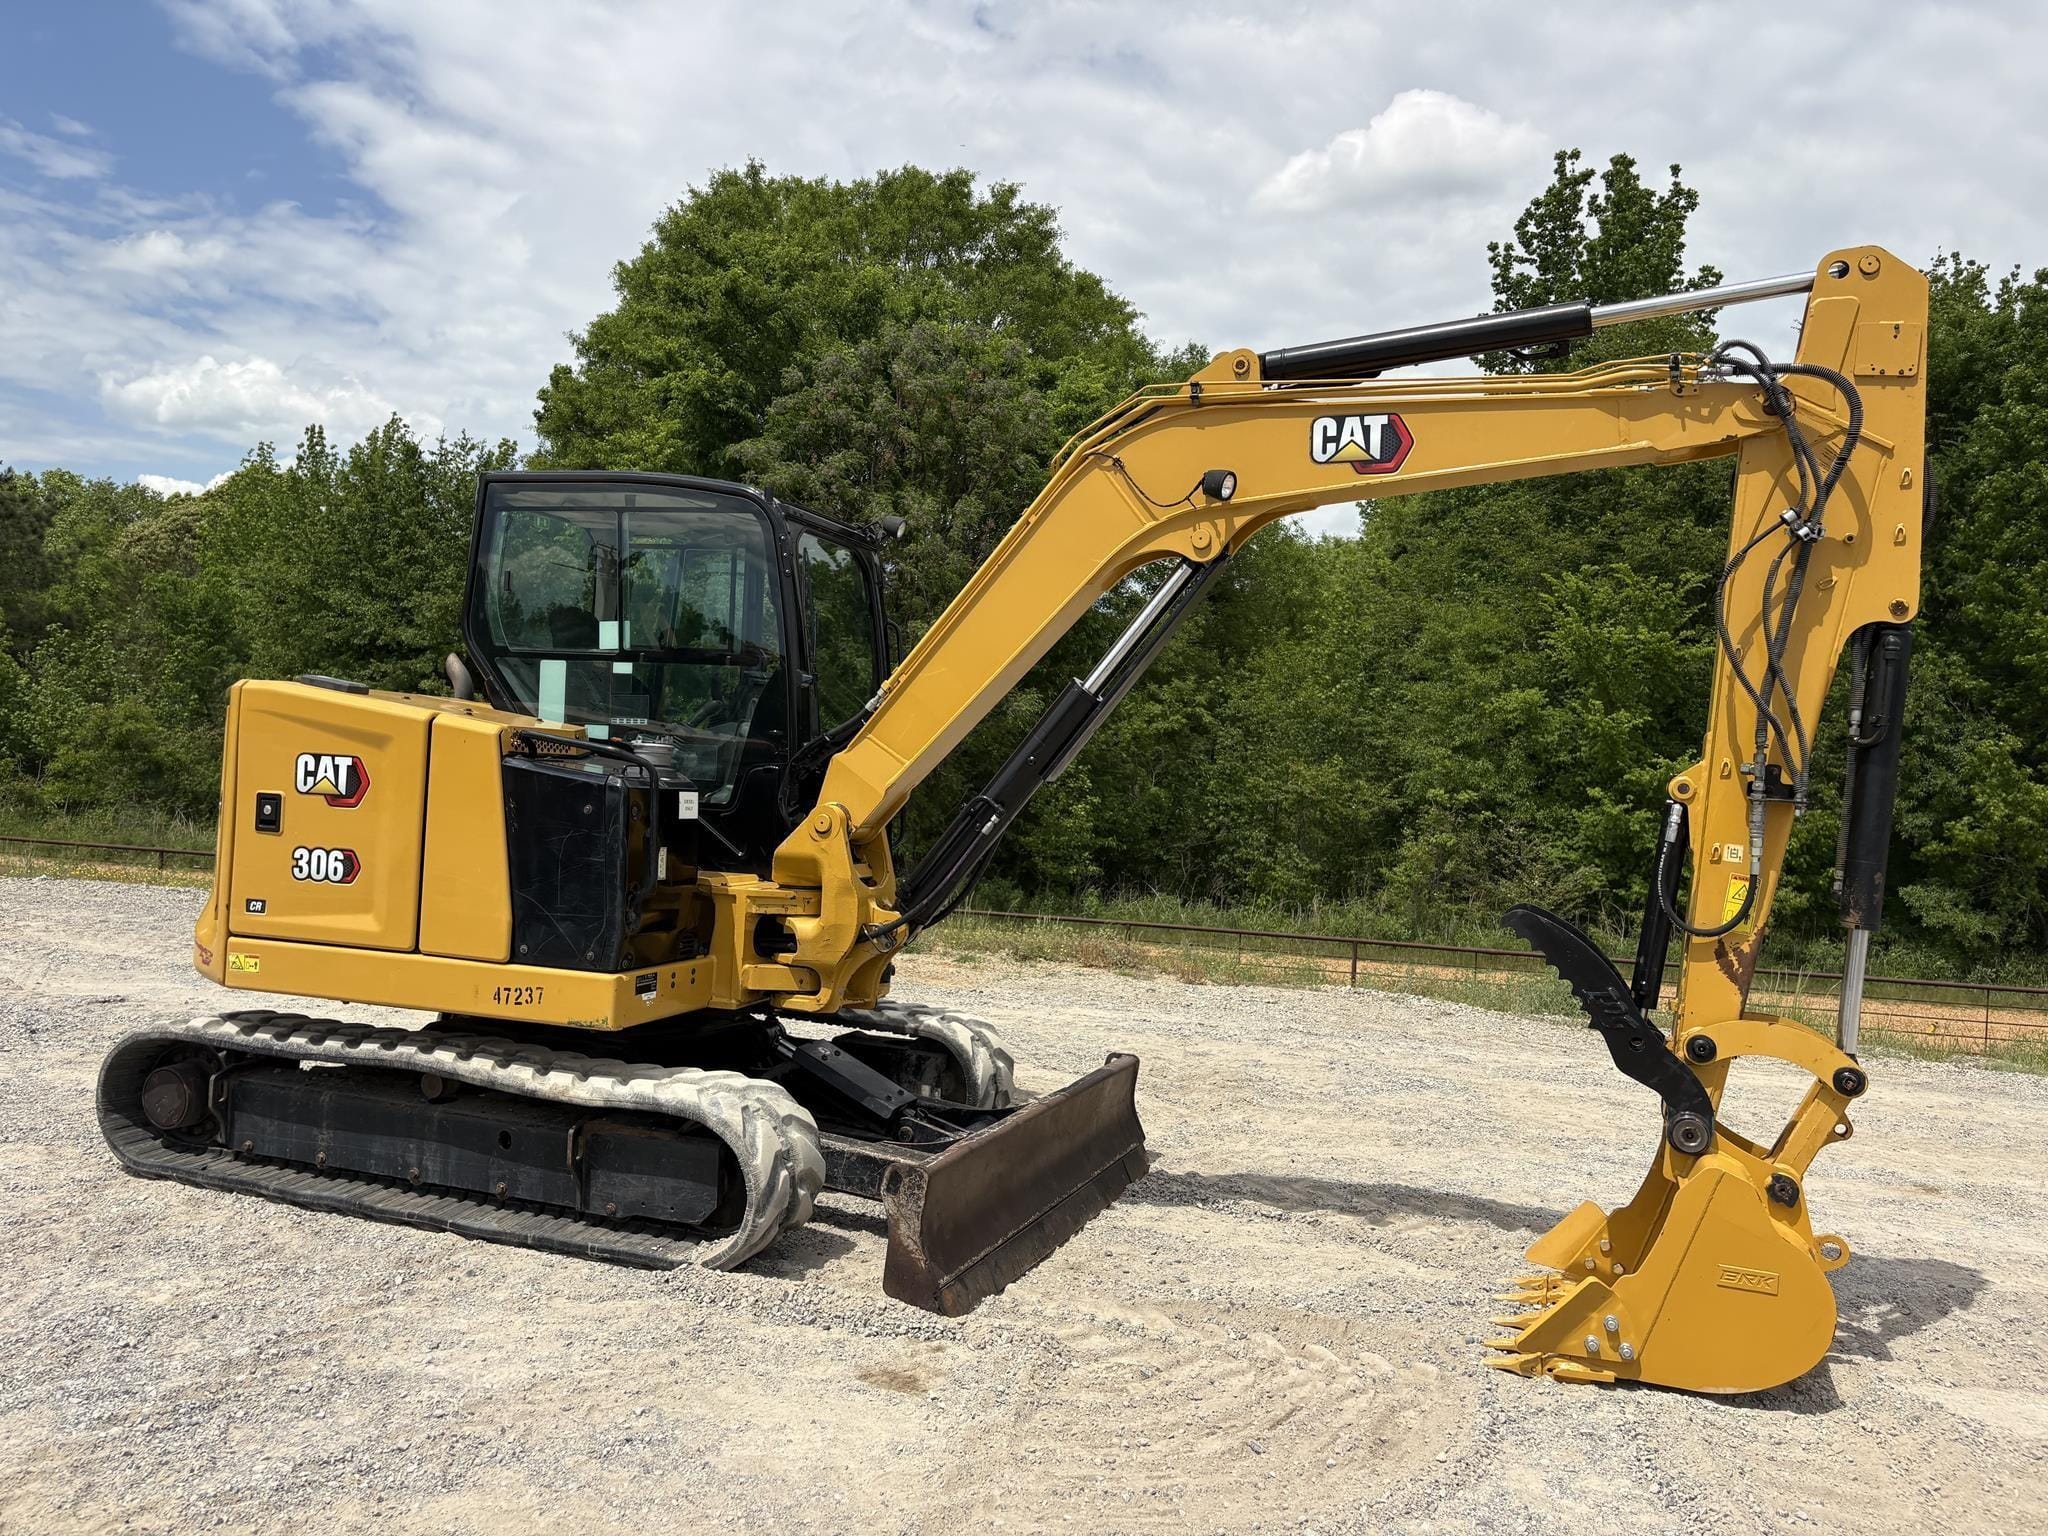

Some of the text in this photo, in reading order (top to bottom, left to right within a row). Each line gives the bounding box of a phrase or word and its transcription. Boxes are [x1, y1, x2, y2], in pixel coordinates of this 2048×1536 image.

[1312, 415, 1388, 463] CAT
[297, 754, 352, 795] CAT
[293, 847, 344, 882] 306
[249, 901, 262, 911] CR
[493, 986, 544, 1005] 47237
